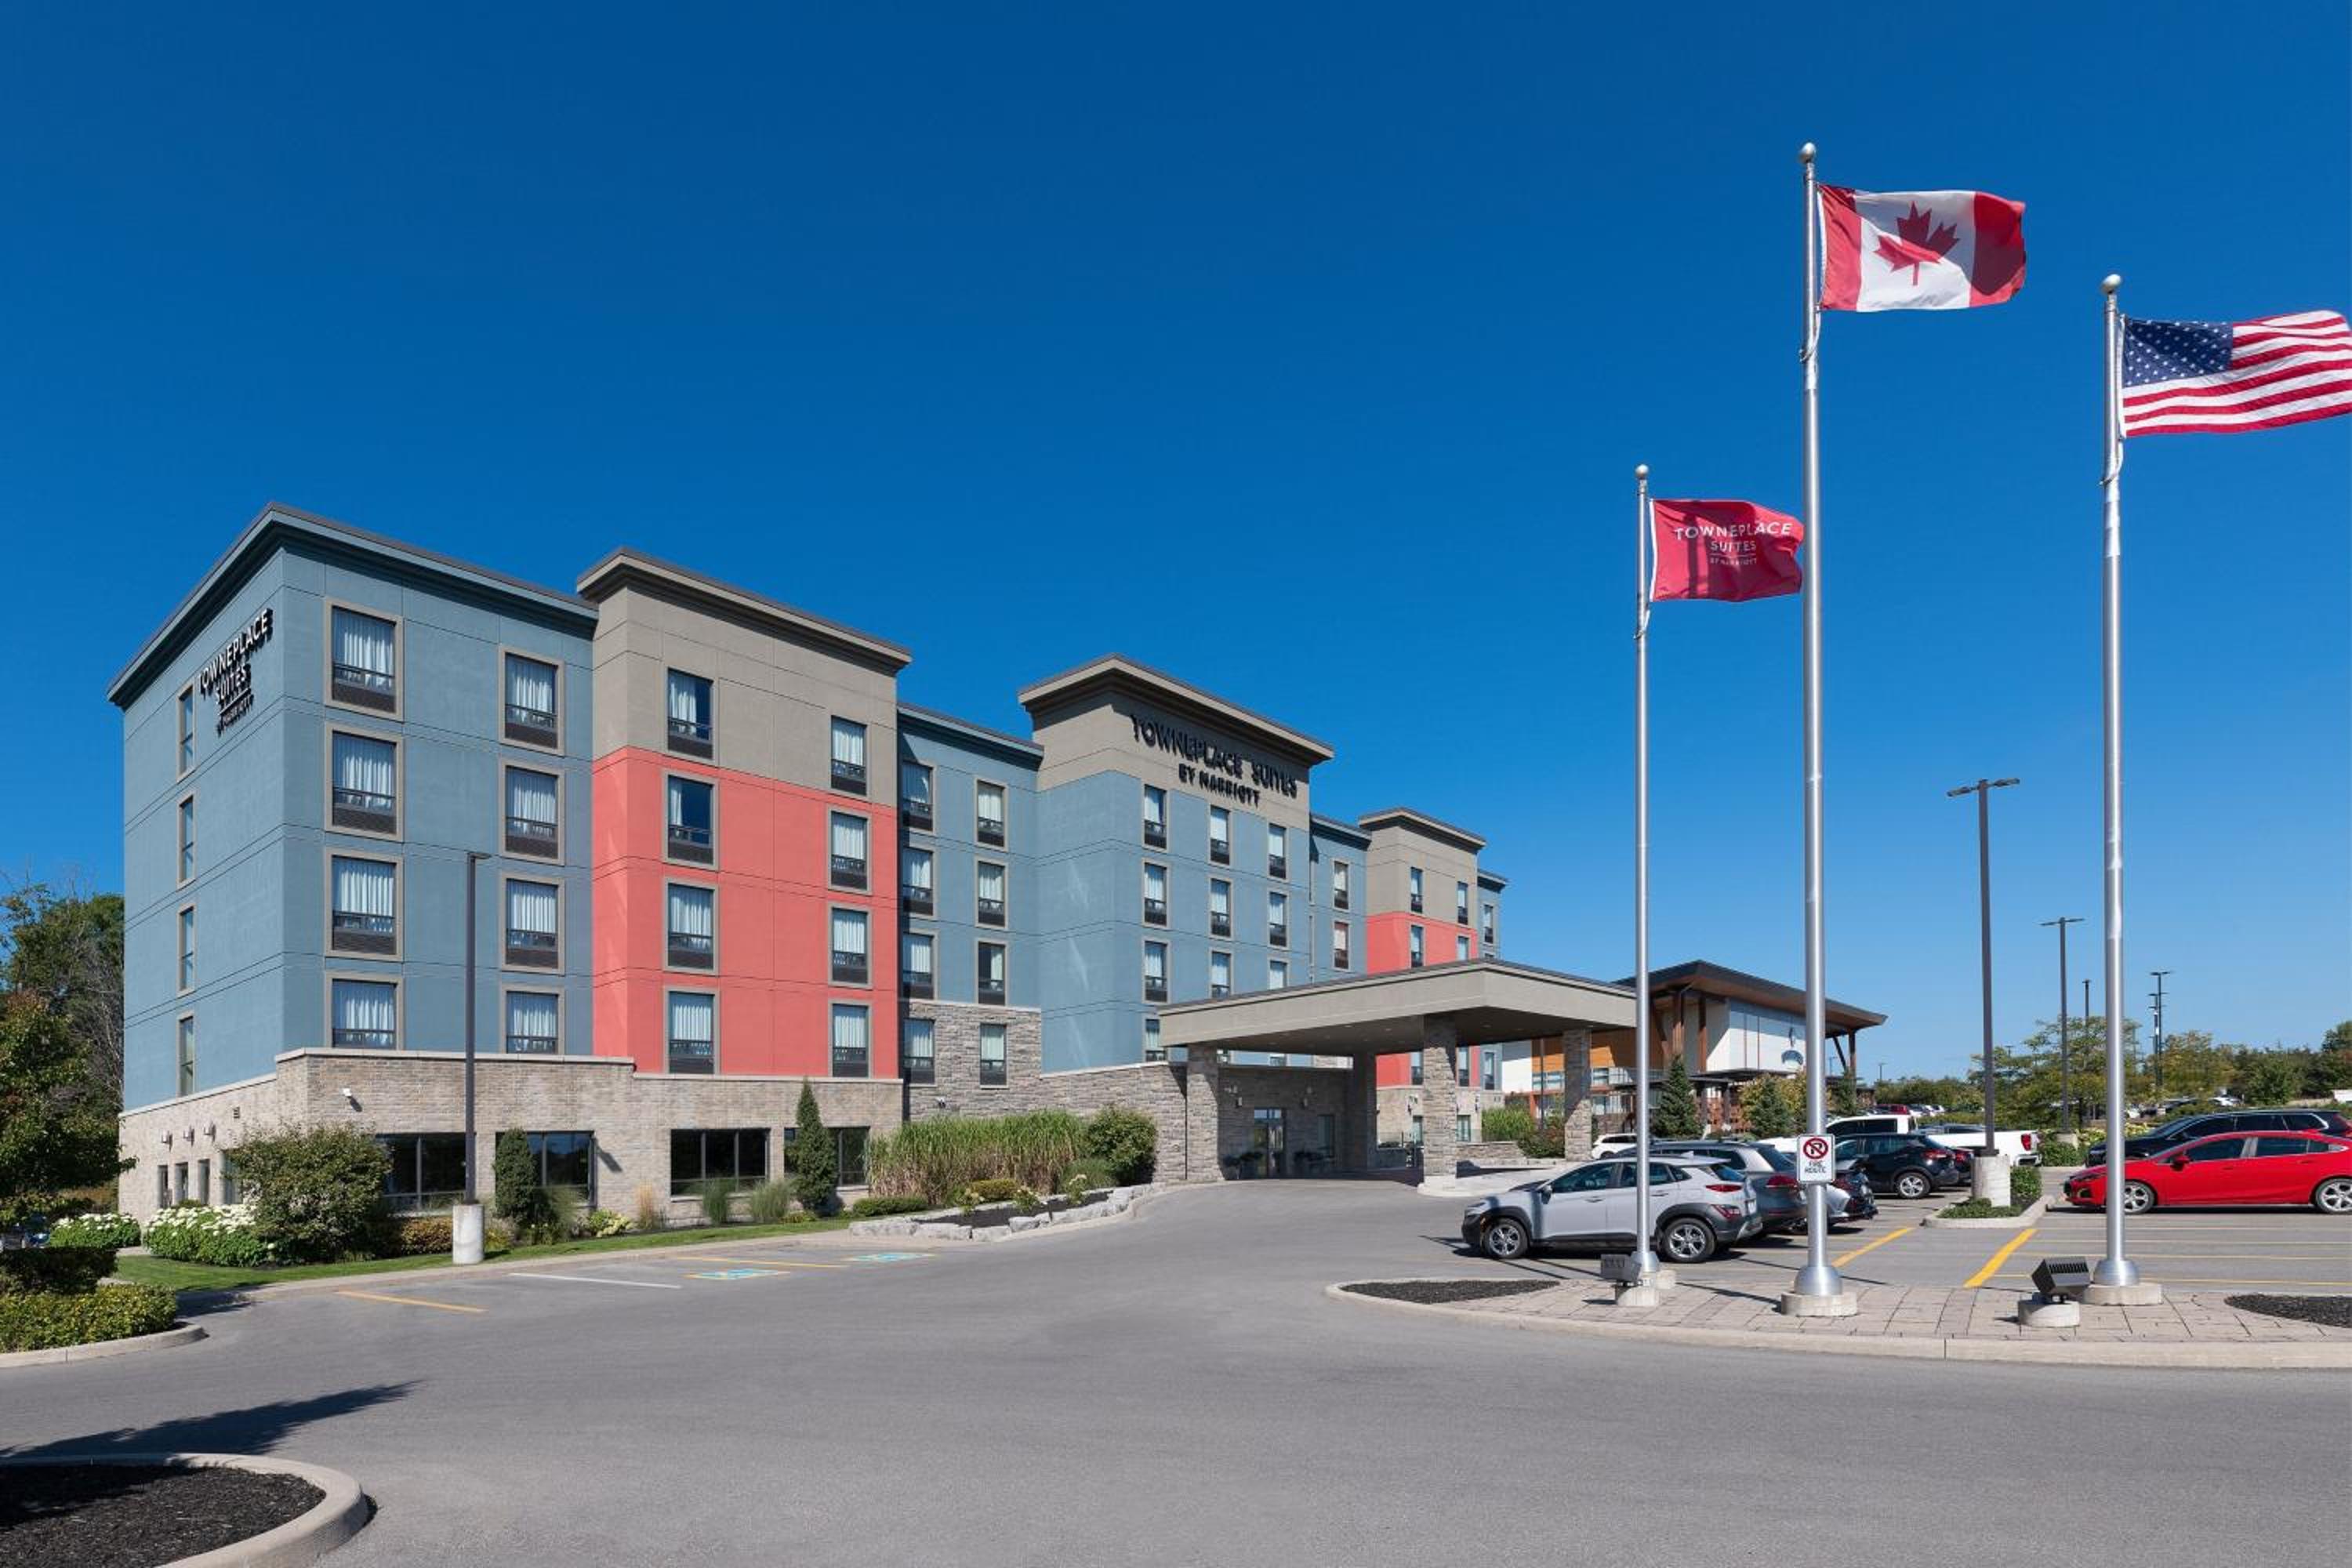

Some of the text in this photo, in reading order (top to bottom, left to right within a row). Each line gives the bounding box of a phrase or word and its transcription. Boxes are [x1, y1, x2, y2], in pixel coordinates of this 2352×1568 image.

[1675, 521, 1792, 540] TOWNEPLACE
[1710, 540, 1756, 552] SUITES
[199, 608, 273, 692] TOWNEPLACE
[216, 663, 252, 706] SUITES
[1131, 714, 1298, 799] TOWNEPLACE SUITES
[1178, 763, 1261, 808] BY MARRIOTT
